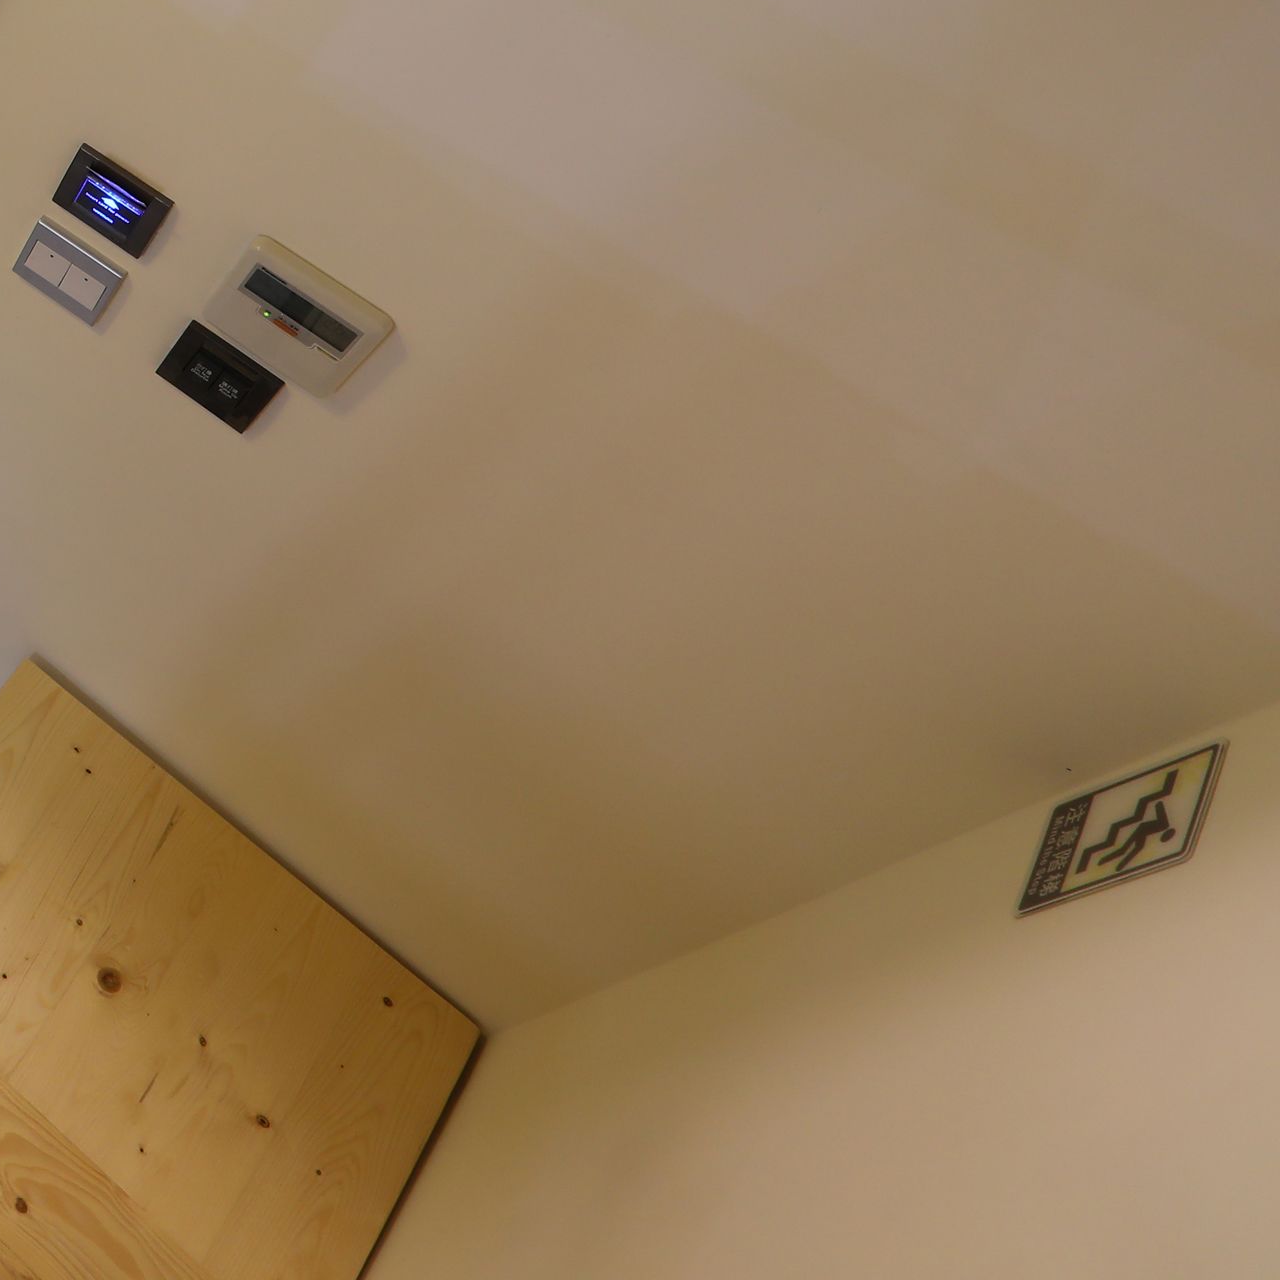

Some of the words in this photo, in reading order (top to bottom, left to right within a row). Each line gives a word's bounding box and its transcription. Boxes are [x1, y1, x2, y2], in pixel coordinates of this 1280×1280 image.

[1047, 815, 1065, 845] Mind
[1038, 802, 1088, 897] 注意階梯
[1039, 846, 1053, 866] the
[1028, 867, 1046, 896] Step
